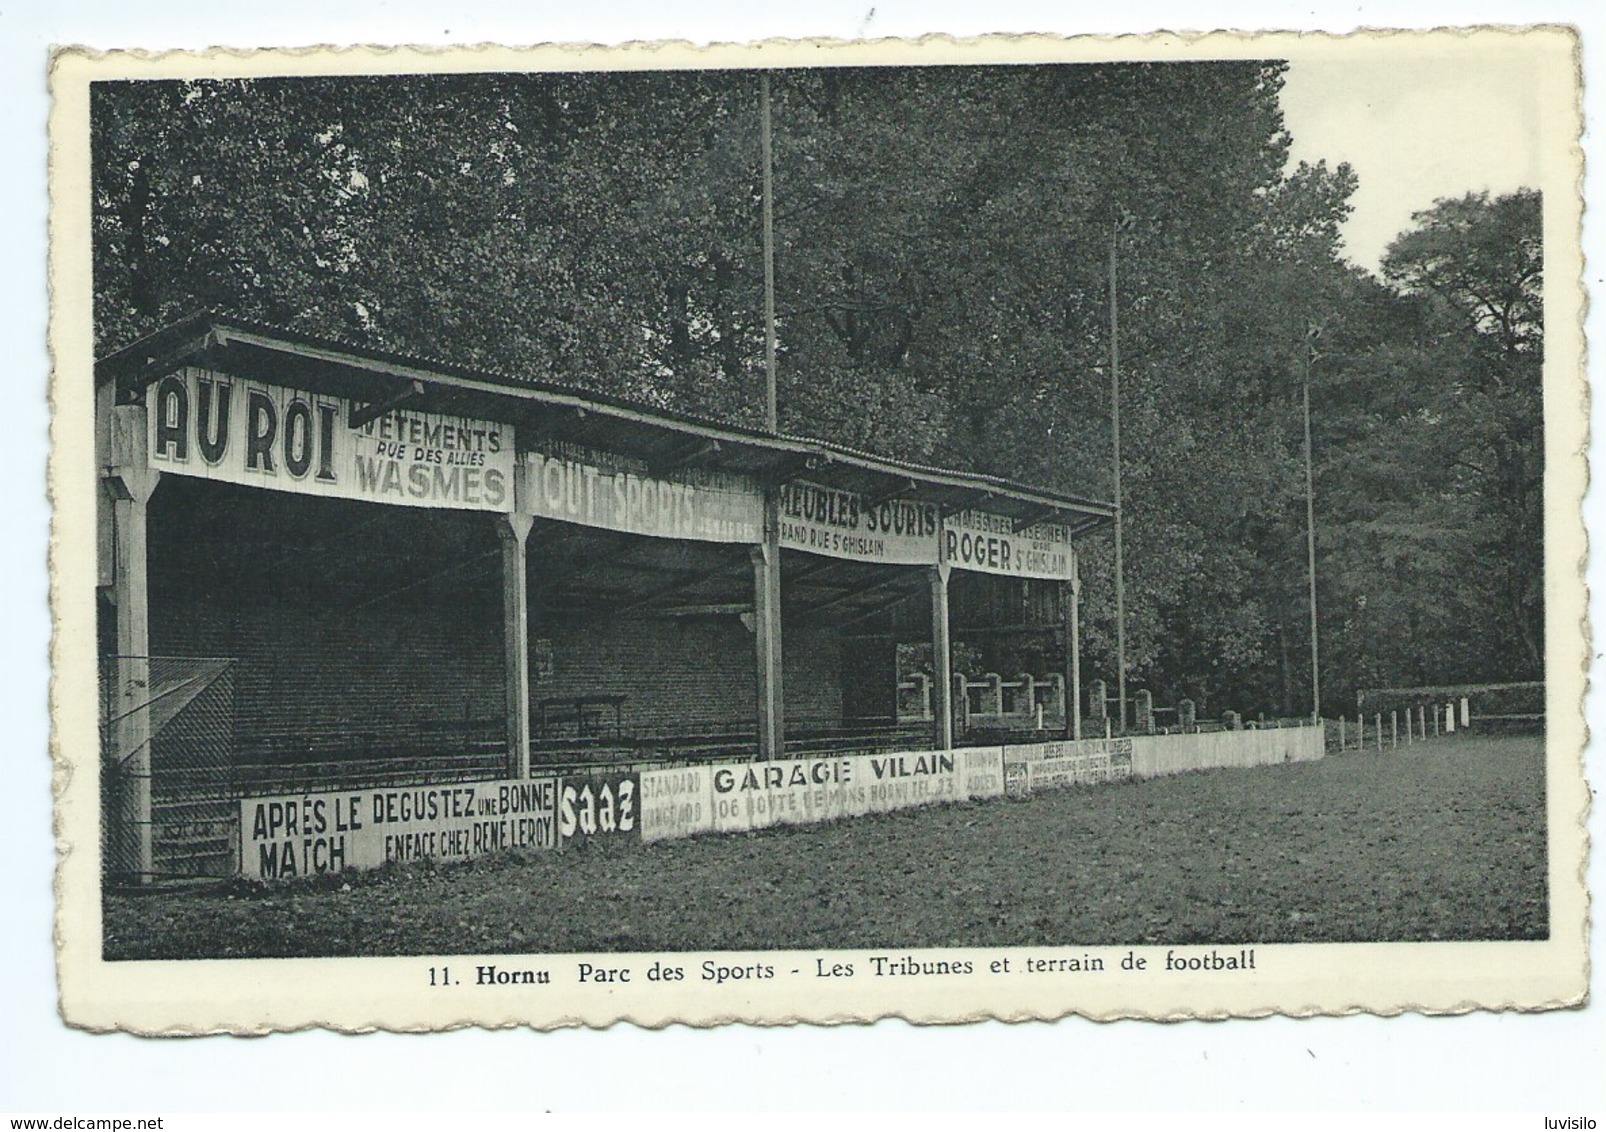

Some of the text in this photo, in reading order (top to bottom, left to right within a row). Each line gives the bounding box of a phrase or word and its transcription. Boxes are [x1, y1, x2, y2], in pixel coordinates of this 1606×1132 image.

[155, 374, 338, 483] AU ROI
[377, 441, 406, 459] RUE
[414, 447, 442, 464] DES
[355, 454, 506, 506] WASMES
[614, 472, 695, 535] SPORTS
[867, 498, 936, 538] SOURIS
[781, 522, 807, 544] RAND
[810, 528, 829, 549] RUE
[843, 535, 884, 557] GHISLAIN
[946, 529, 1011, 571] ROGER
[1027, 550, 1067, 575] GHISLAIN
[643, 771, 701, 798] STANDARD
[714, 753, 954, 793] GARAGE VILAIN
[335, 796, 363, 832] LE
[373, 782, 553, 824] DEGUSTEZ UNE BONNE
[441, 829, 470, 857] CHEZ
[474, 815, 507, 854] RENÉ
[511, 816, 552, 849] LEROY
[259, 836, 345, 880] MATCH
